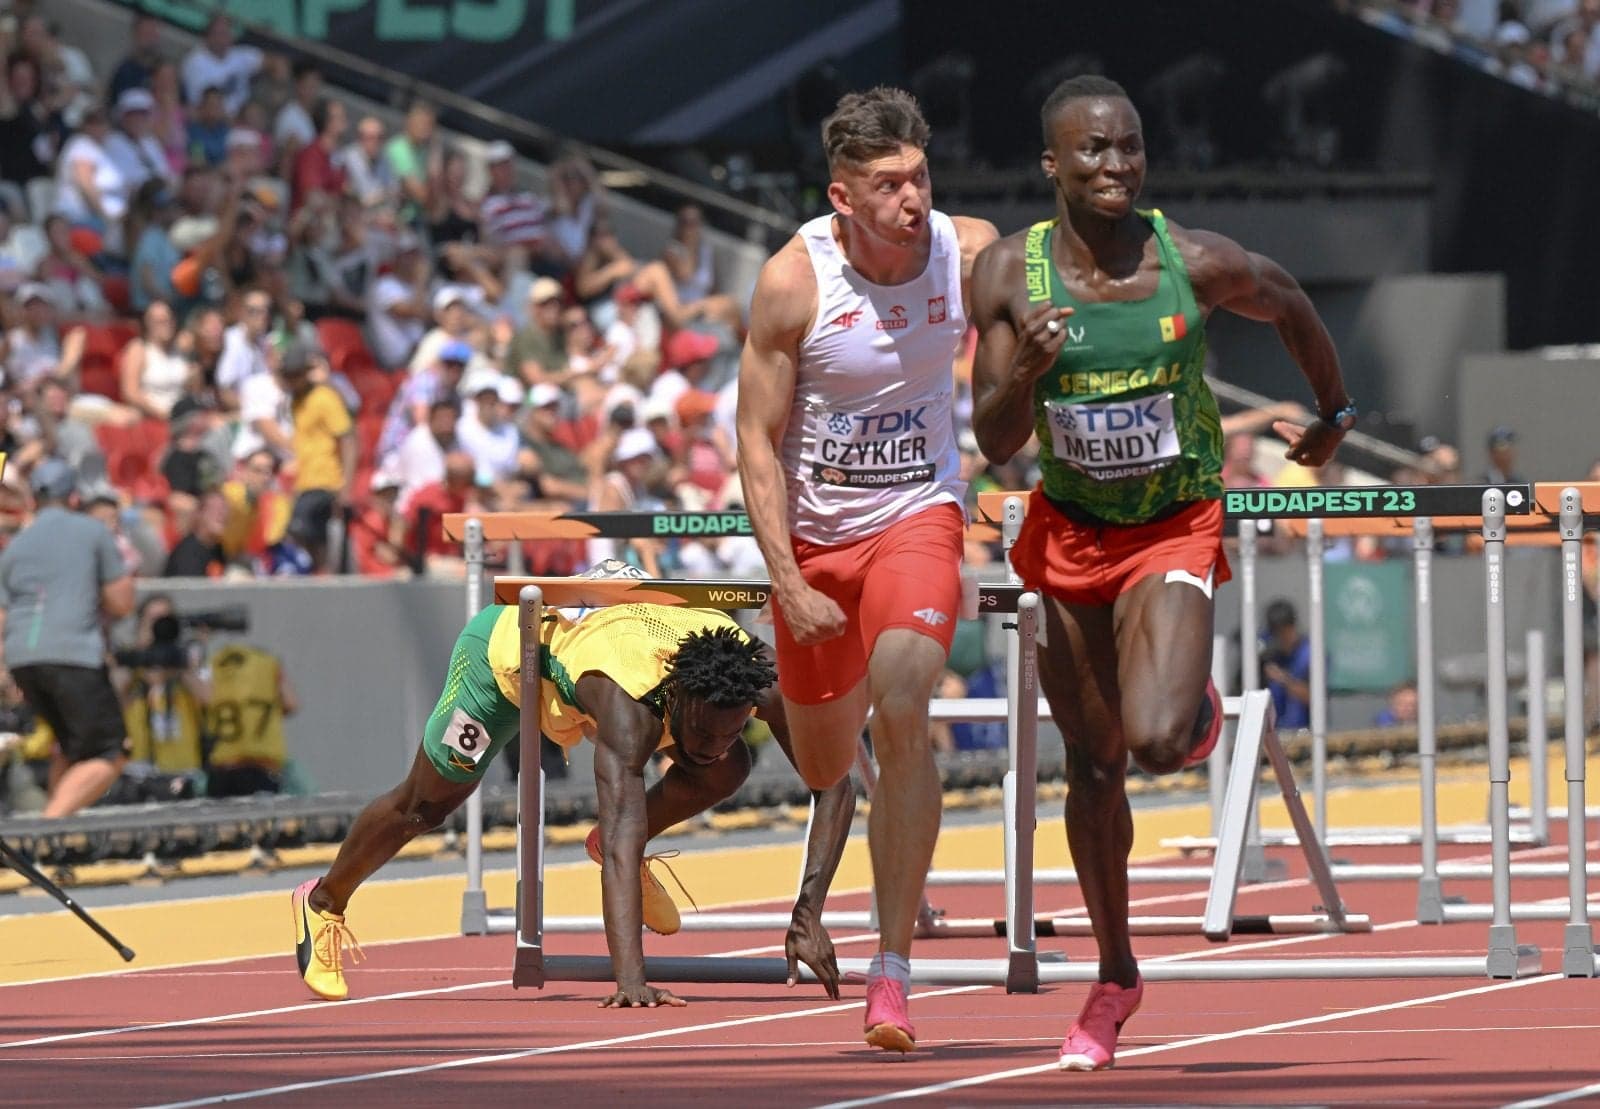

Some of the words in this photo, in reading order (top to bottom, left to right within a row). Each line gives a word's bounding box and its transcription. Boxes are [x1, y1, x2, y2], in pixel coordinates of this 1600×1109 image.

[1059, 362, 1182, 394] SENEGAL
[853, 406, 927, 436] TDK
[1076, 400, 1162, 432] TDK
[822, 436, 926, 465] CZYKIER
[1064, 429, 1161, 462] MENDY
[849, 471, 914, 484] BUDAPEST
[1226, 492, 1379, 513] BUDAPEST
[1383, 491, 1416, 511] 23
[653, 515, 753, 534] BUDAPE
[708, 590, 767, 602] WORLD
[458, 723, 481, 751] 8
